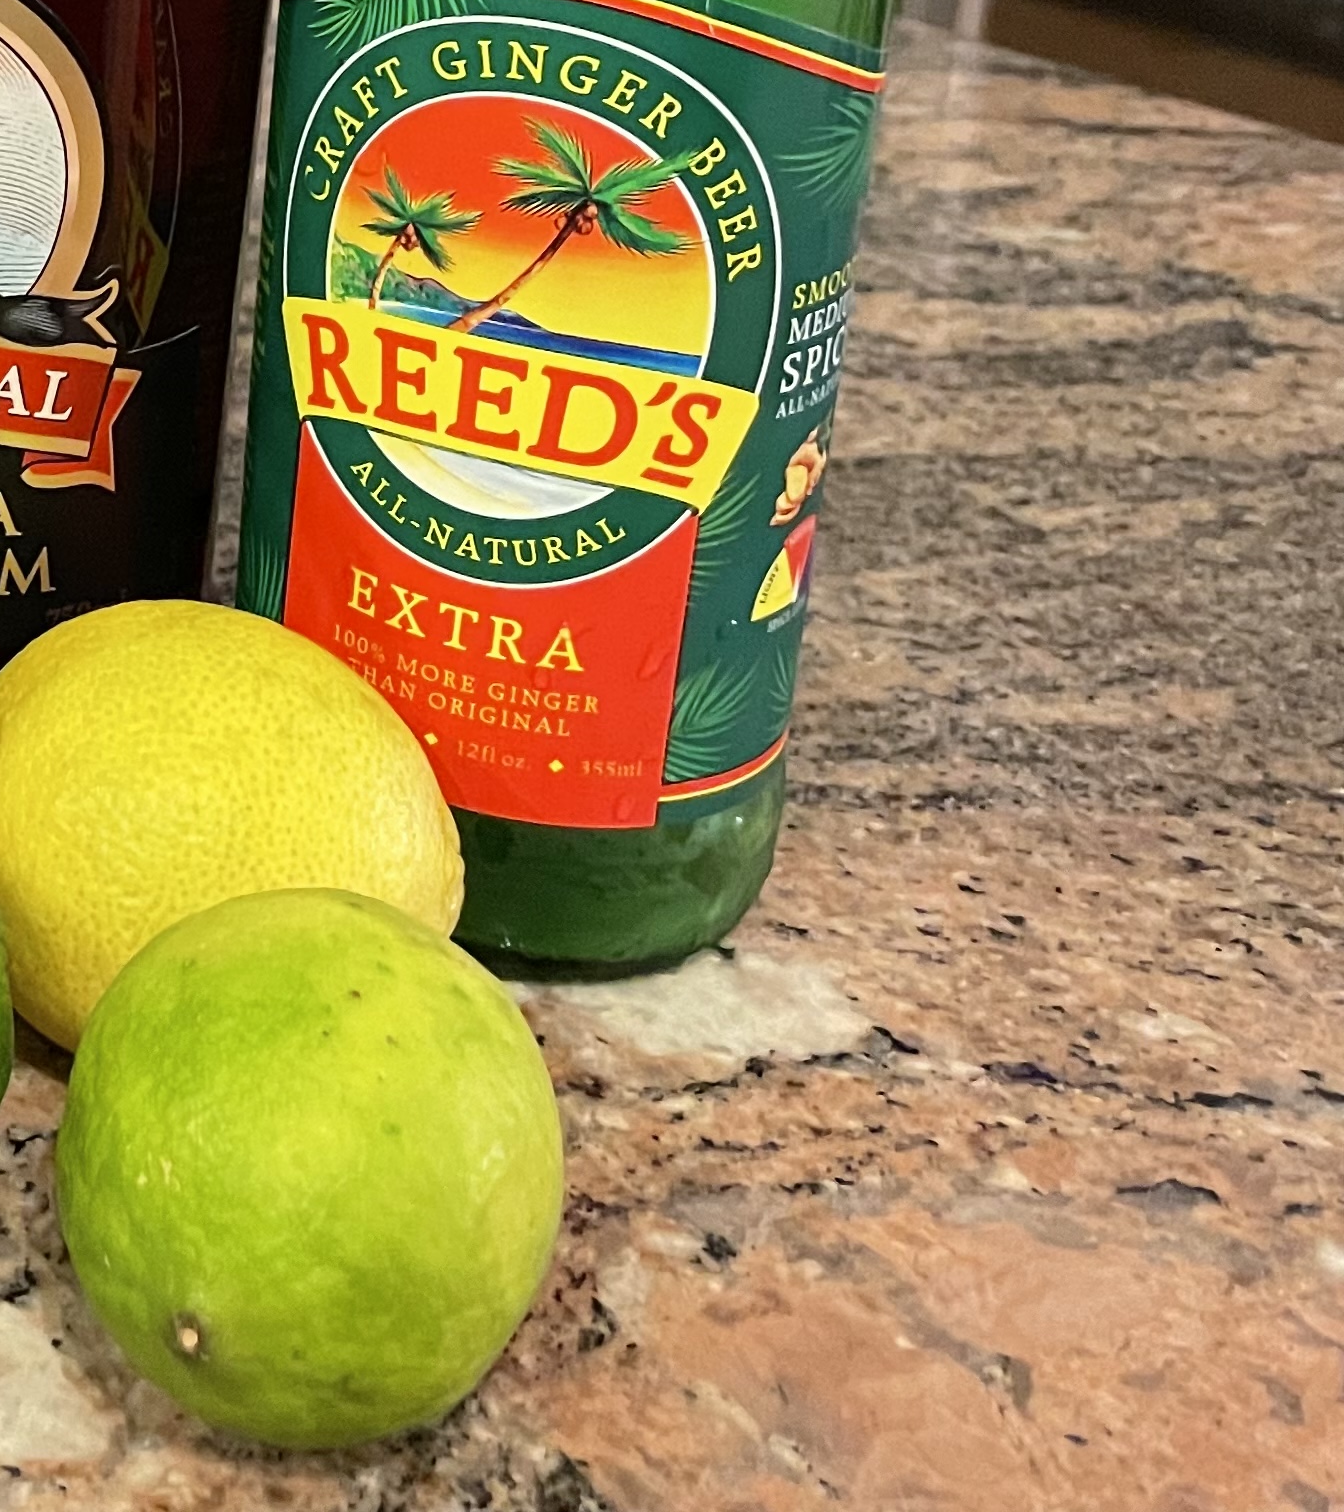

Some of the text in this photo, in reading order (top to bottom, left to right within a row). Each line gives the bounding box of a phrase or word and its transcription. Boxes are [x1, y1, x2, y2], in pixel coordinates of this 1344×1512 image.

[303, 55, 409, 202] CRAFT
[431, 40, 683, 140] GINGER
[688, 137, 763, 283] BEER
[791, 262, 854, 311] SMOO
[300, 312, 722, 478] REED'S
[779, 325, 847, 395] SPIC
[349, 458, 627, 567] ALL-NATURAL
[332, 623, 600, 715] 100% MORE GINGER
[347, 566, 585, 673] EXTRA
[427, 691, 571, 738] ORIGINAL
